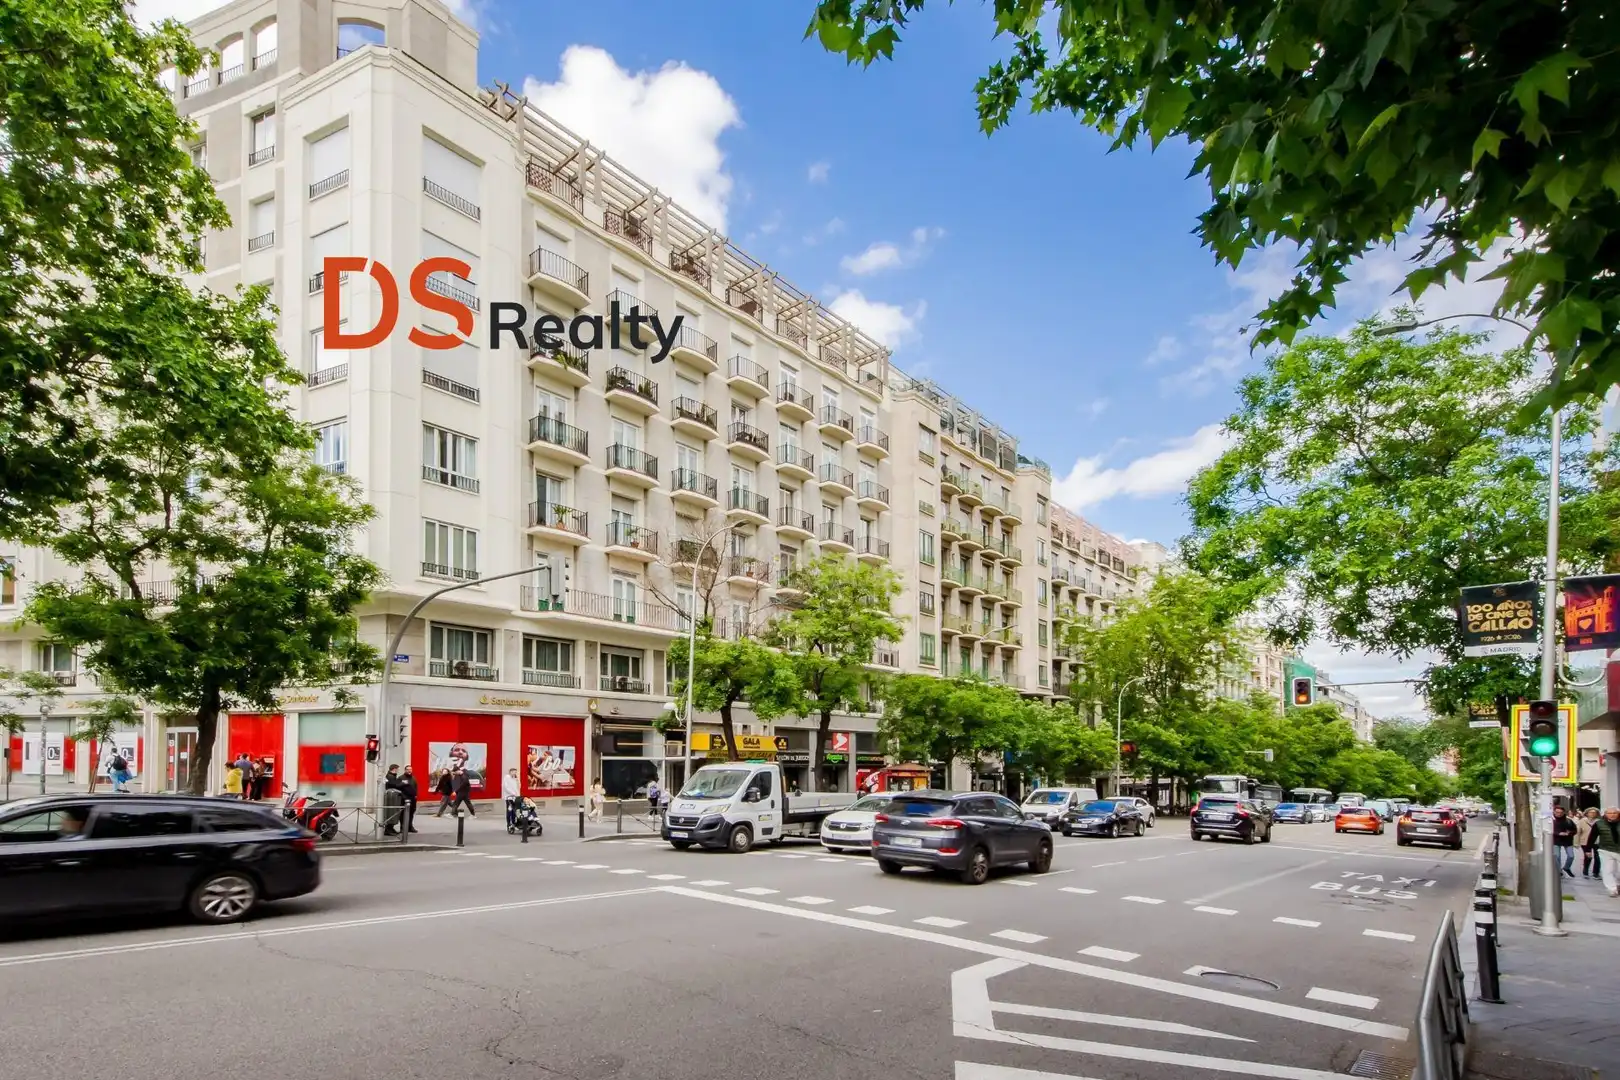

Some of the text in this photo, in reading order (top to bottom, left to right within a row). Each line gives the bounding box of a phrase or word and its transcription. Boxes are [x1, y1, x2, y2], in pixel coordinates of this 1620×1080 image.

[1466, 600, 1532, 614] 100 AÑOS
[1467, 609, 1533, 622] DE CINE EN
[1467, 617, 1534, 633] CALLAO
[491, 696, 532, 708] Santander
[742, 737, 760, 745] GALA
[1340, 871, 1437, 887] TAXI
[1309, 881, 1418, 899] BUS
